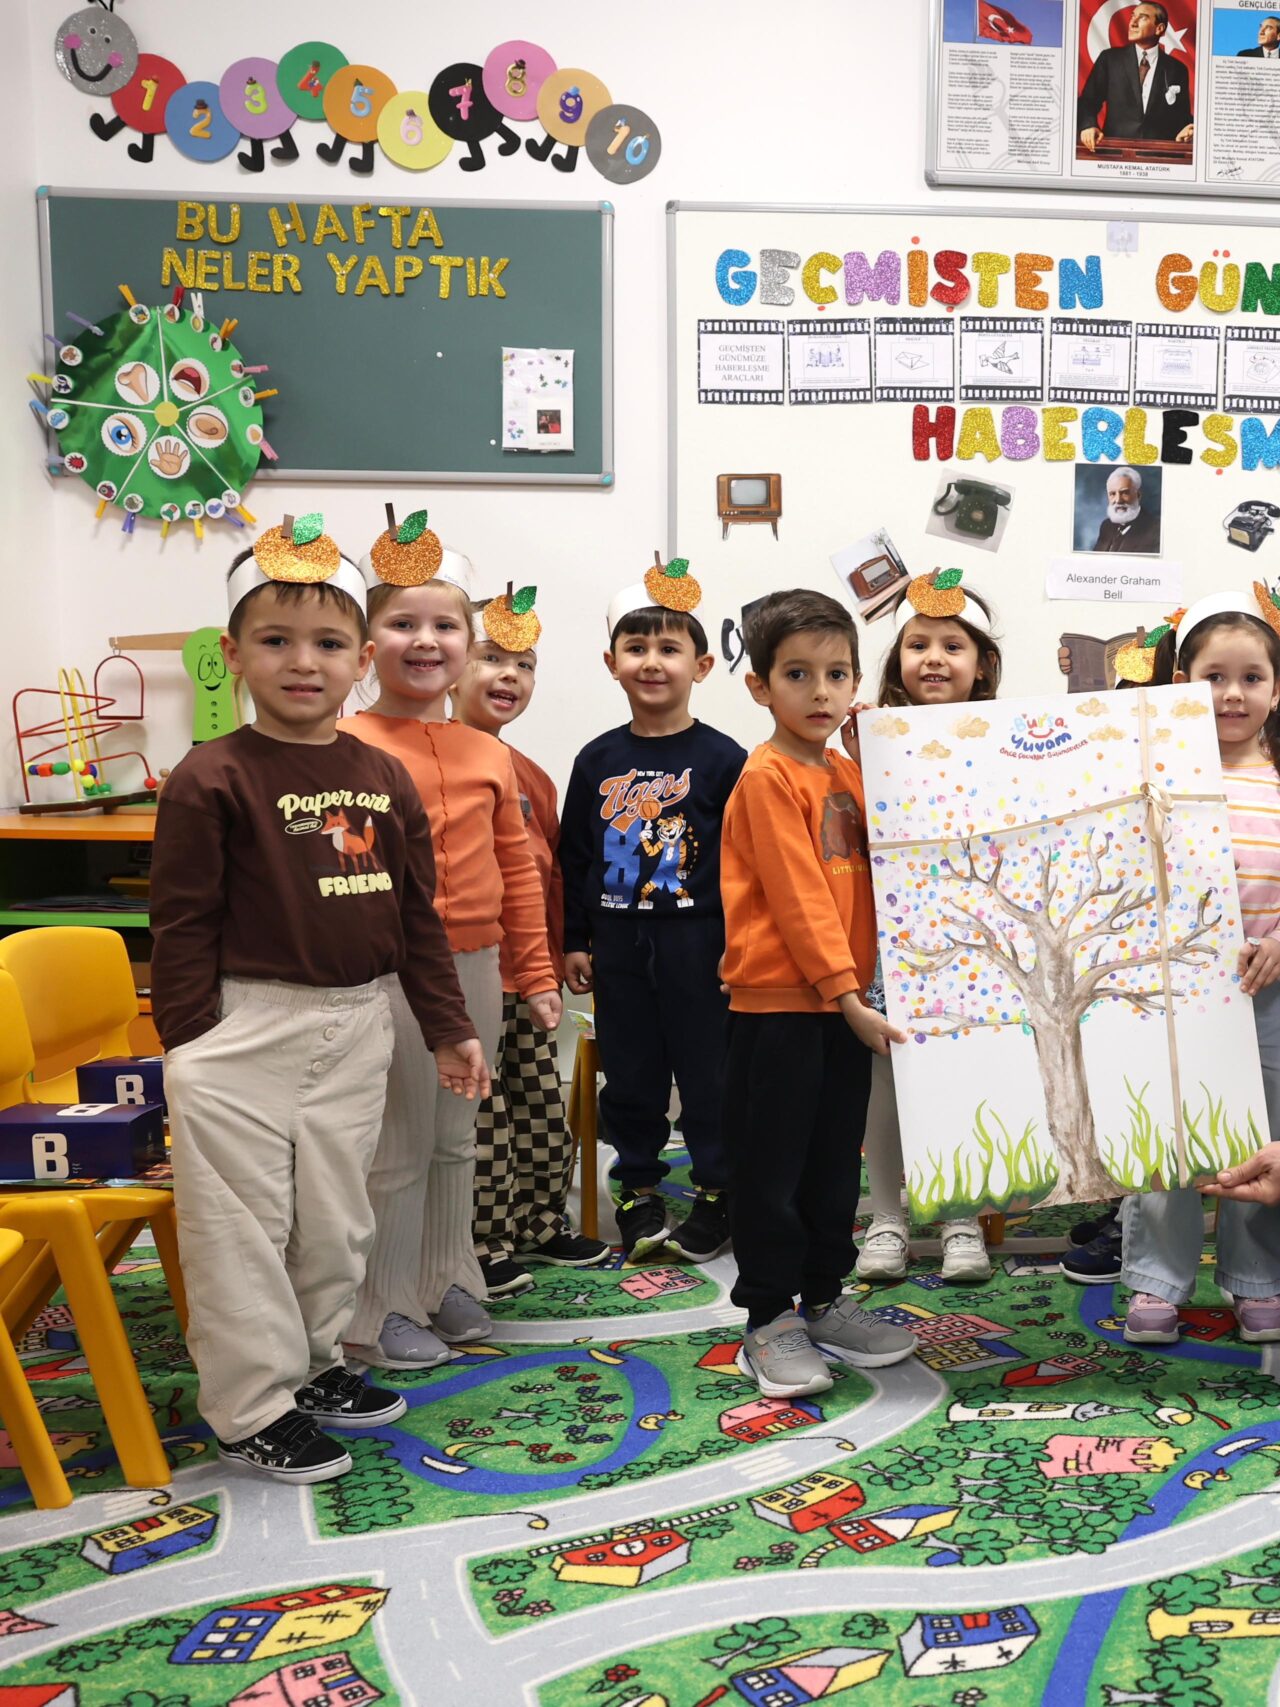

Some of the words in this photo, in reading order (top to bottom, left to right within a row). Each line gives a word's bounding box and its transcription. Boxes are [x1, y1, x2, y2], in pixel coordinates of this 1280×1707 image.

[141, 79, 156, 110] 1
[189, 107, 212, 138] 2
[244, 82, 267, 114] 3
[297, 64, 322, 93] 4
[350, 86, 372, 118] 5
[400, 116, 424, 145] 6
[448, 86, 474, 120] 7
[504, 63, 528, 97] 8
[558, 91, 584, 122] 9
[606, 124, 651, 165] 10
[1097, 163, 1123, 171] MUSTAFA
[176, 200, 241, 244] BU
[268, 200, 443, 249] HAFTA
[161, 246, 302, 293] NELER
[326, 251, 510, 300] YAPTIK
[715, 236, 1104, 314] GEÇMİŞTEN
[718, 343, 766, 353] GEÇMİŞTEN
[718, 353, 766, 362] GÜNÜMÜZE
[715, 363, 770, 373] HABERLEŞME
[721, 373, 764, 383] ARAÇLARI
[1066, 573, 1117, 585] Alexander
[1120, 575, 1161, 586] Graham
[1103, 590, 1123, 600] Bell
[1014, 714, 1065, 733] Bursa
[1011, 733, 1072, 752] Yuvam
[999, 747, 1017, 759] Önce
[599, 767, 693, 820] Tigers
[277, 789, 355, 820] Paper
[355, 792, 391, 814] art
[317, 872, 393, 898] FRIEND
[32, 1133, 70, 1179] B
